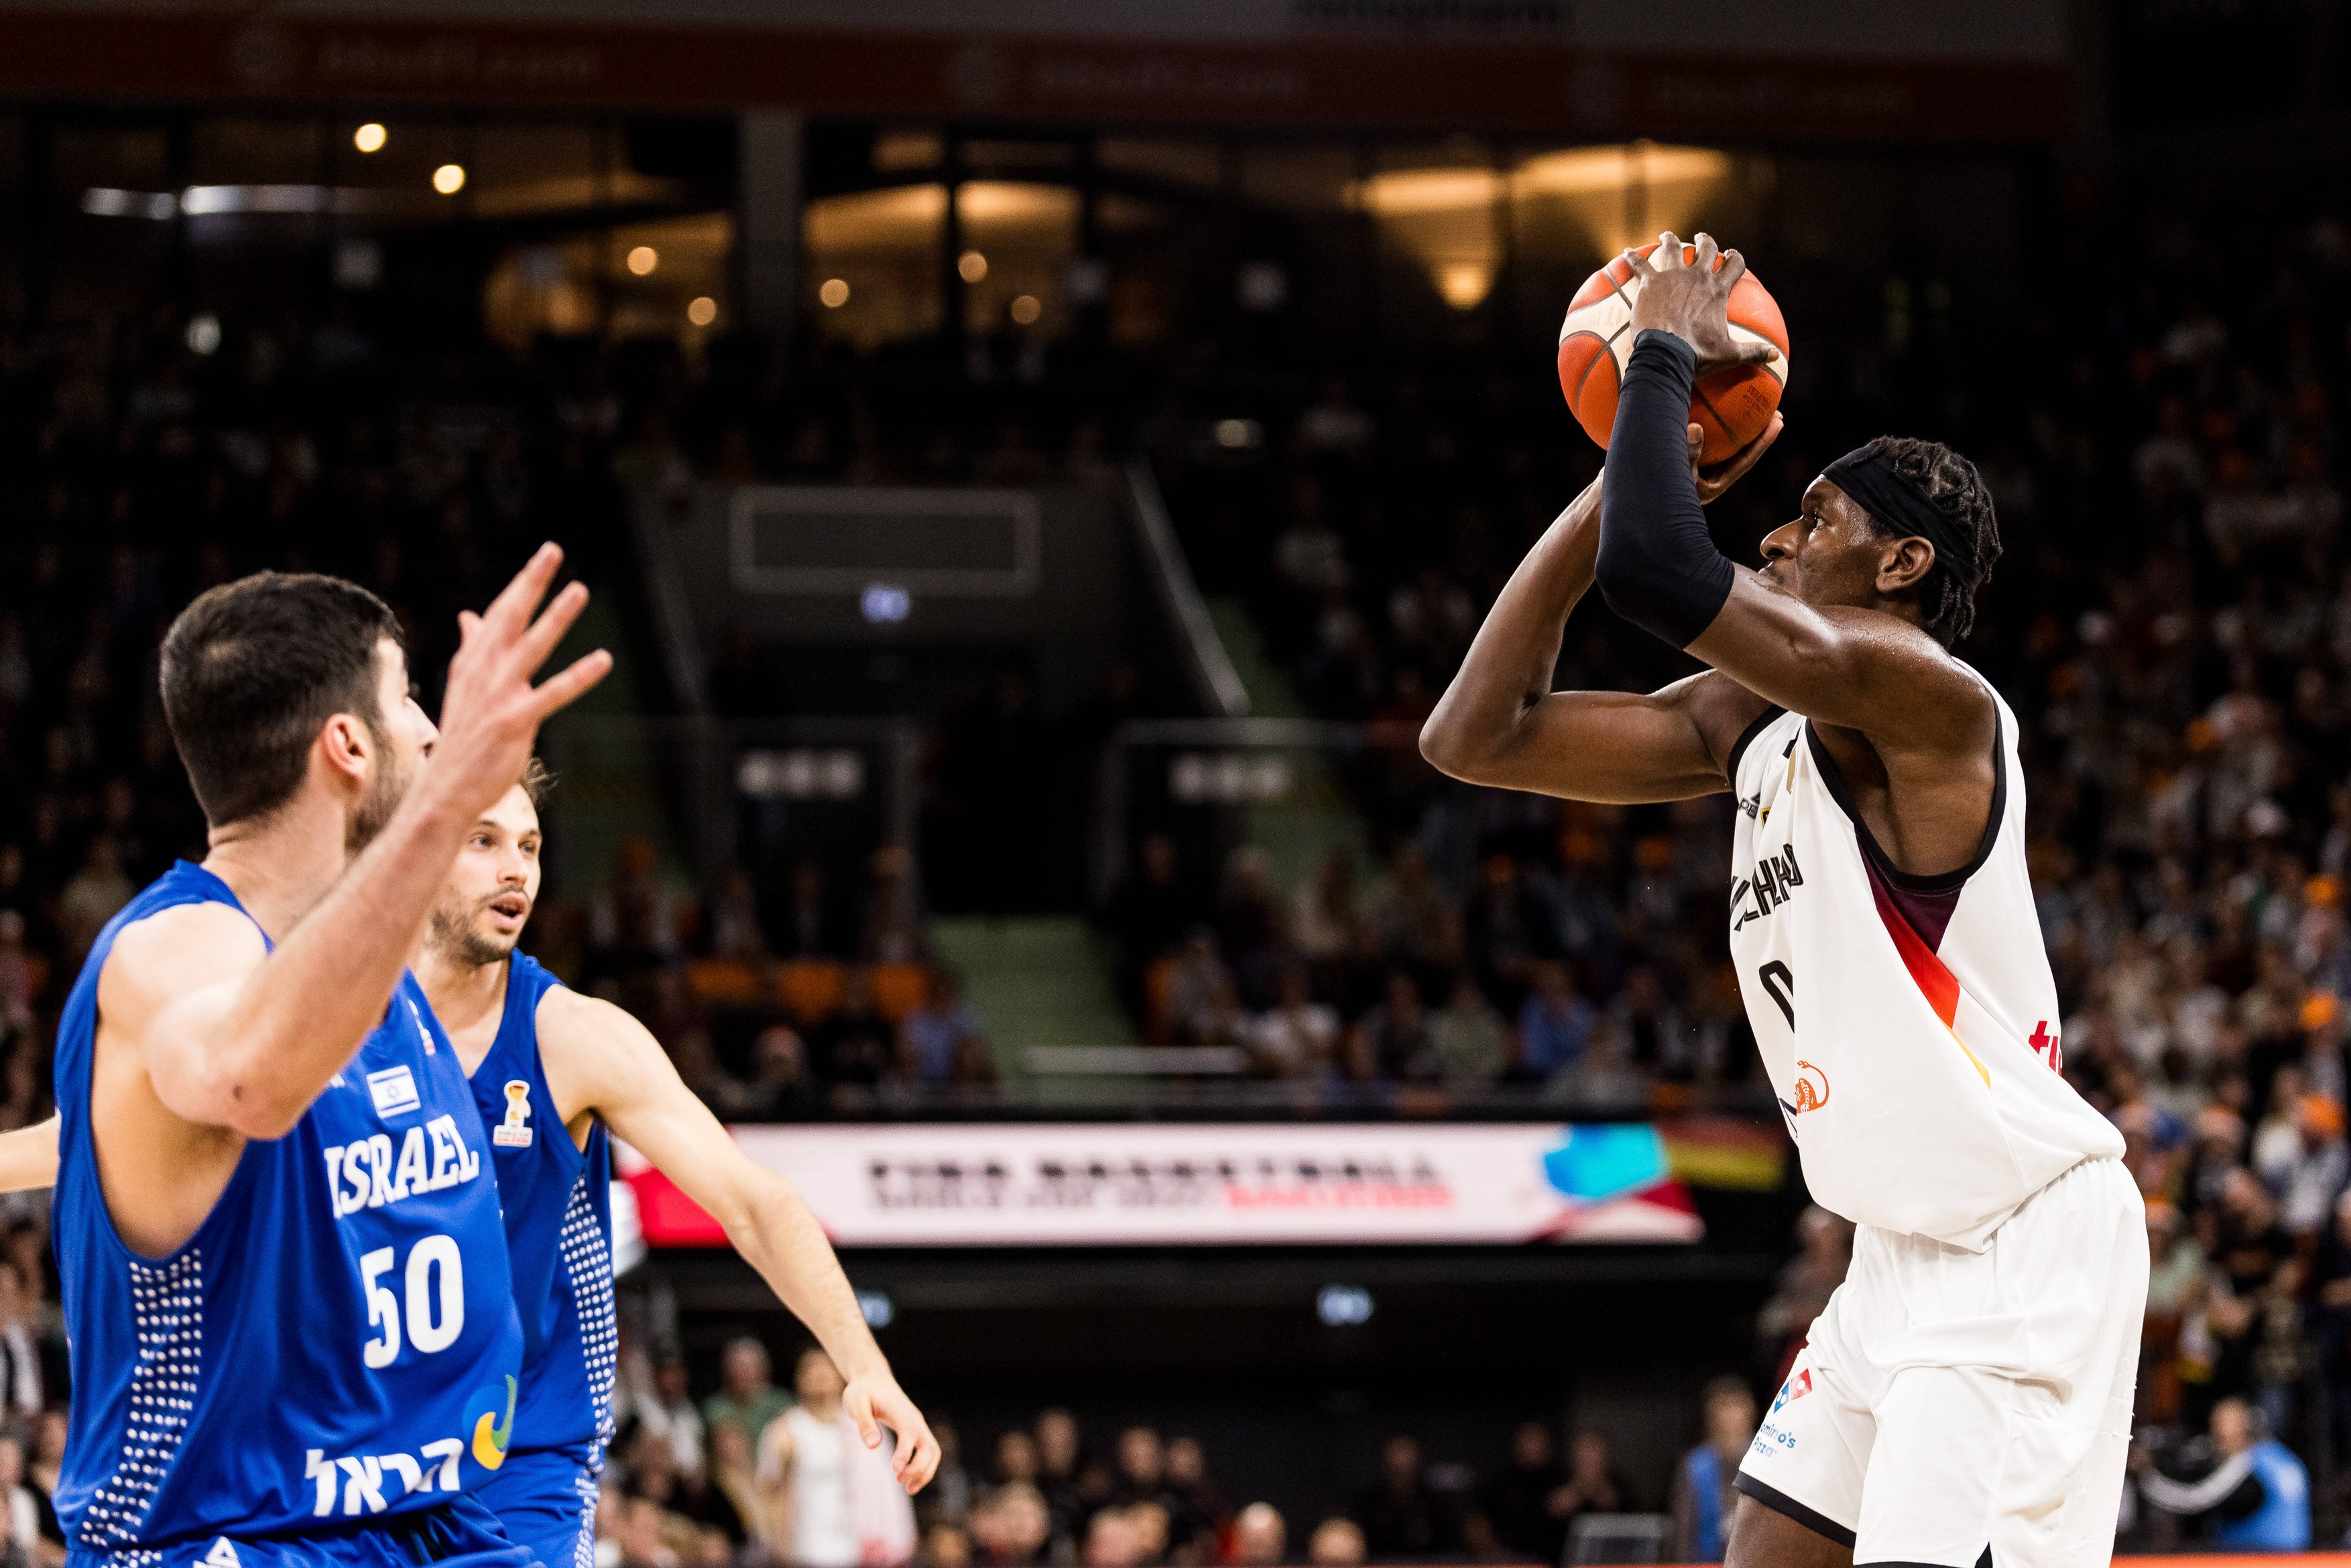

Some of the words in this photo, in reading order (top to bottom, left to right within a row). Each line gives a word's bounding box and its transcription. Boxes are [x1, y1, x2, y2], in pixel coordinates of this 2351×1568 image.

[324, 1114, 479, 1219] ISRAEL
[360, 1234, 464, 1369] 50
[304, 1437, 464, 1518] הראל
[1760, 1423, 1797, 1449] omino's
